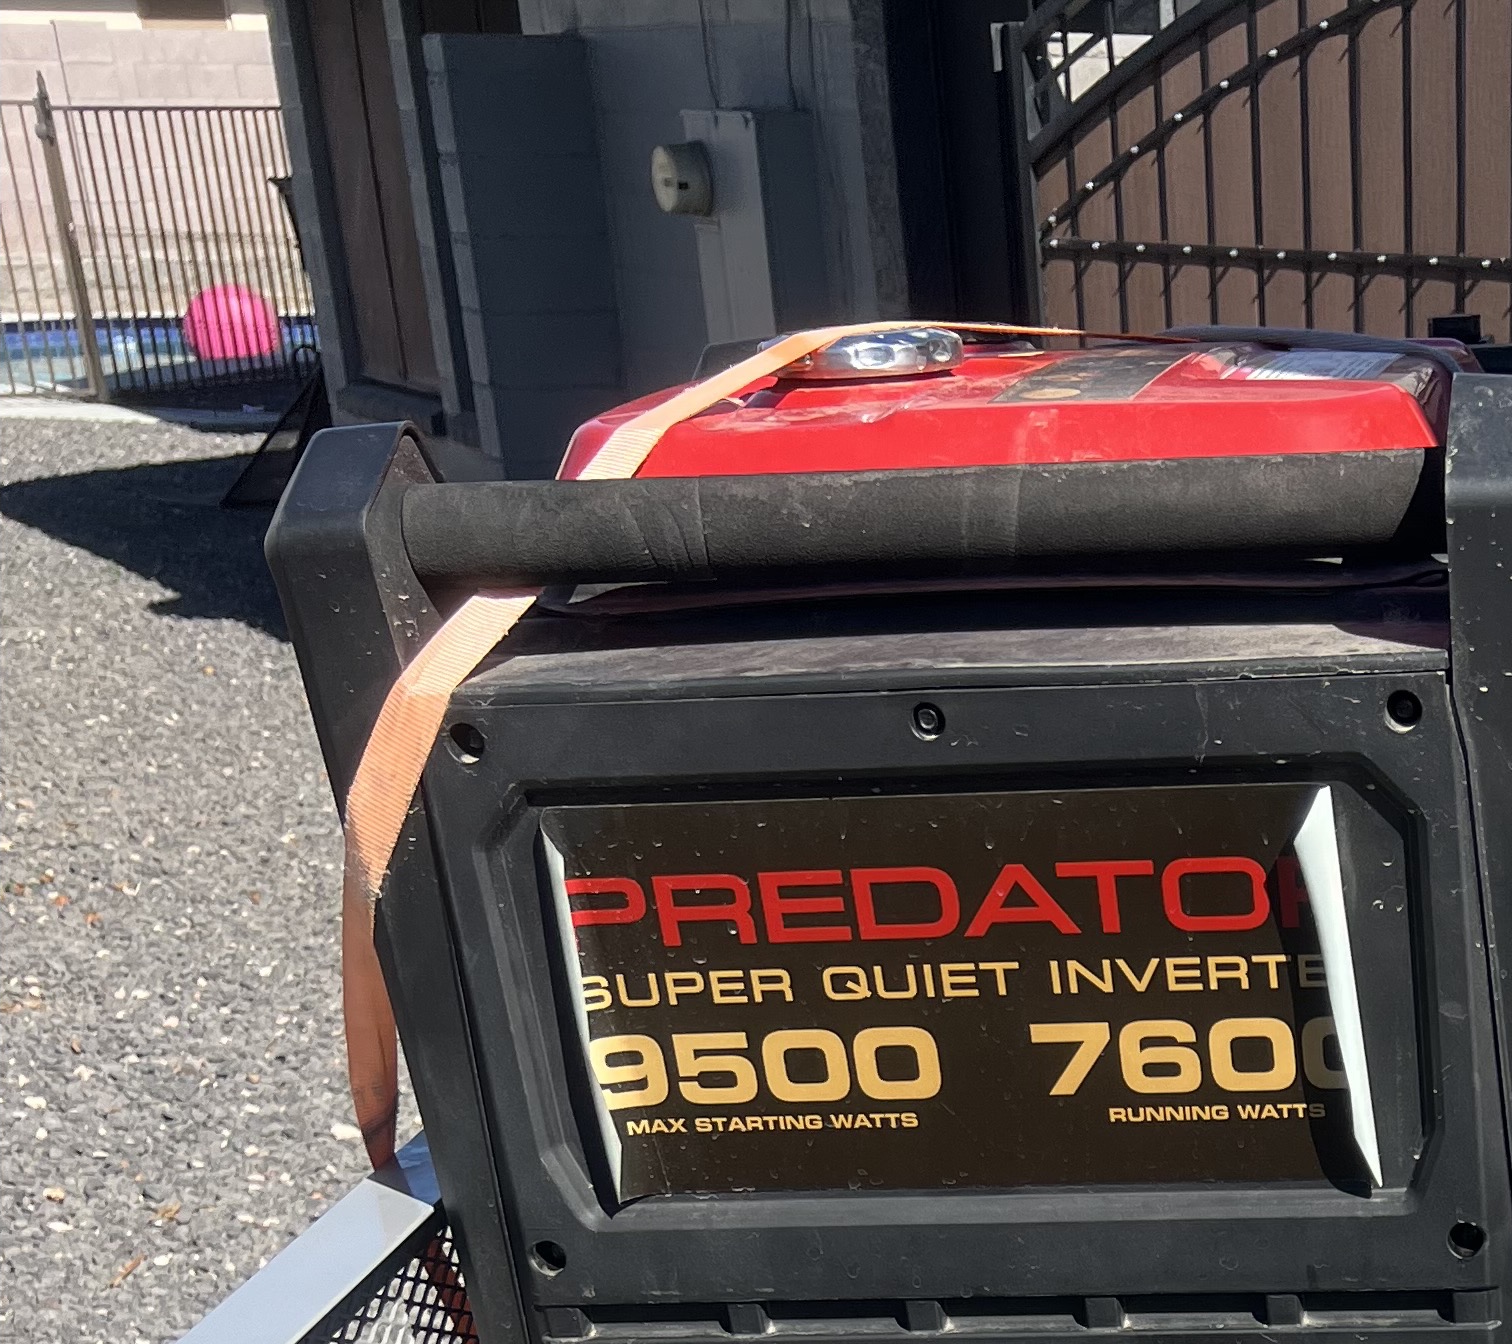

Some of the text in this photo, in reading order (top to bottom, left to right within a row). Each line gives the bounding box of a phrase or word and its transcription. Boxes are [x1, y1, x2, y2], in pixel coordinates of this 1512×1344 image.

[565, 856, 1310, 952] PREDATO
[582, 968, 793, 1011] SUPER
[822, 961, 1020, 1001] QUIET
[589, 1025, 942, 1111] 9500
[626, 1112, 919, 1136] MAX STARTING WATTS
[1108, 1103, 1326, 1123] RUNNING WATTS
